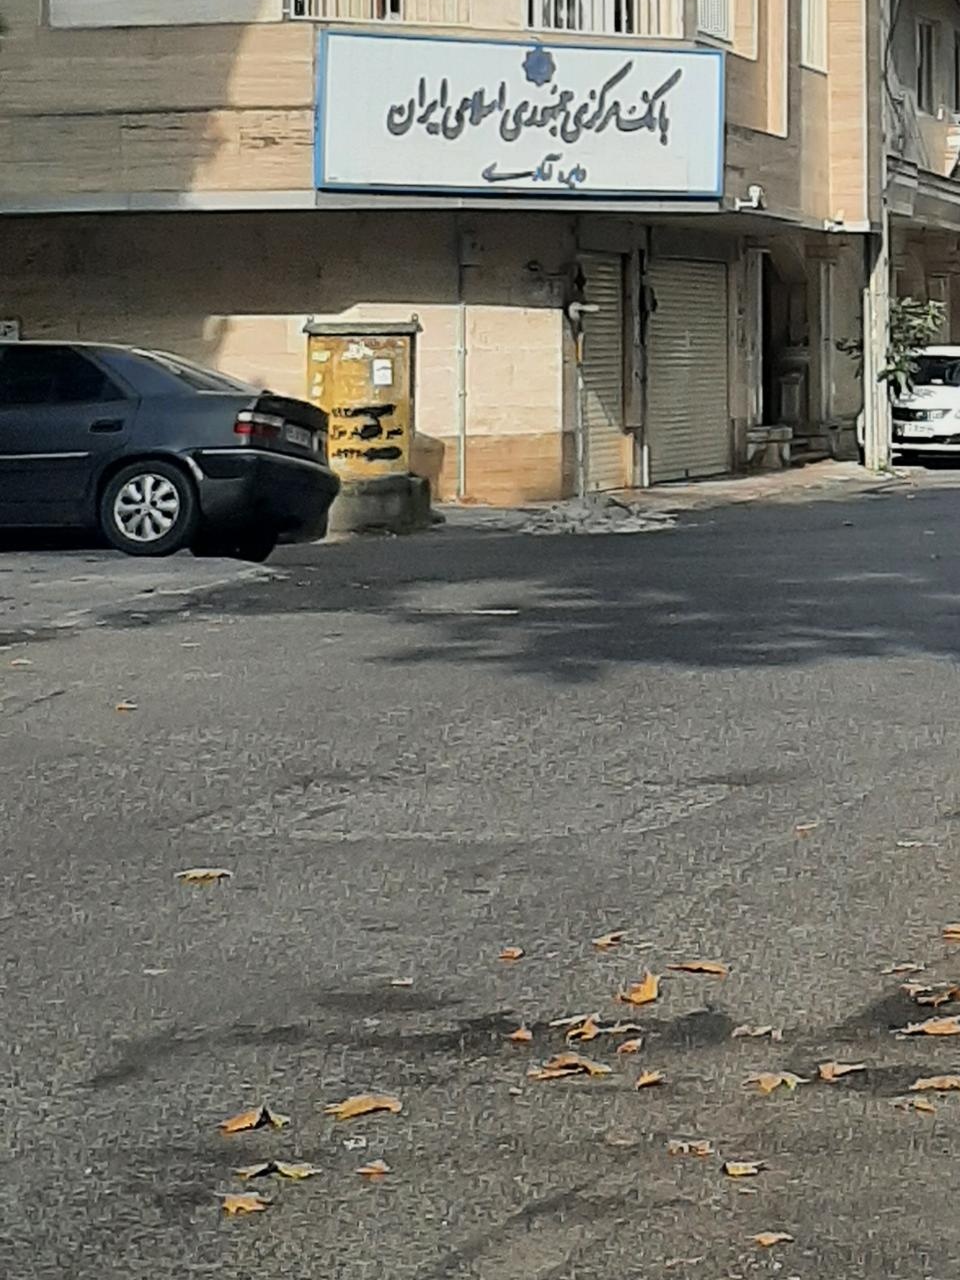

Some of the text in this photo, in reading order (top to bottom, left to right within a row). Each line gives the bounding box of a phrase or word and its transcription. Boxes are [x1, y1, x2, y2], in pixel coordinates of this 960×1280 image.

[387, 61, 683, 146] بانک مرکزی جمهوری اسلامی ایران
